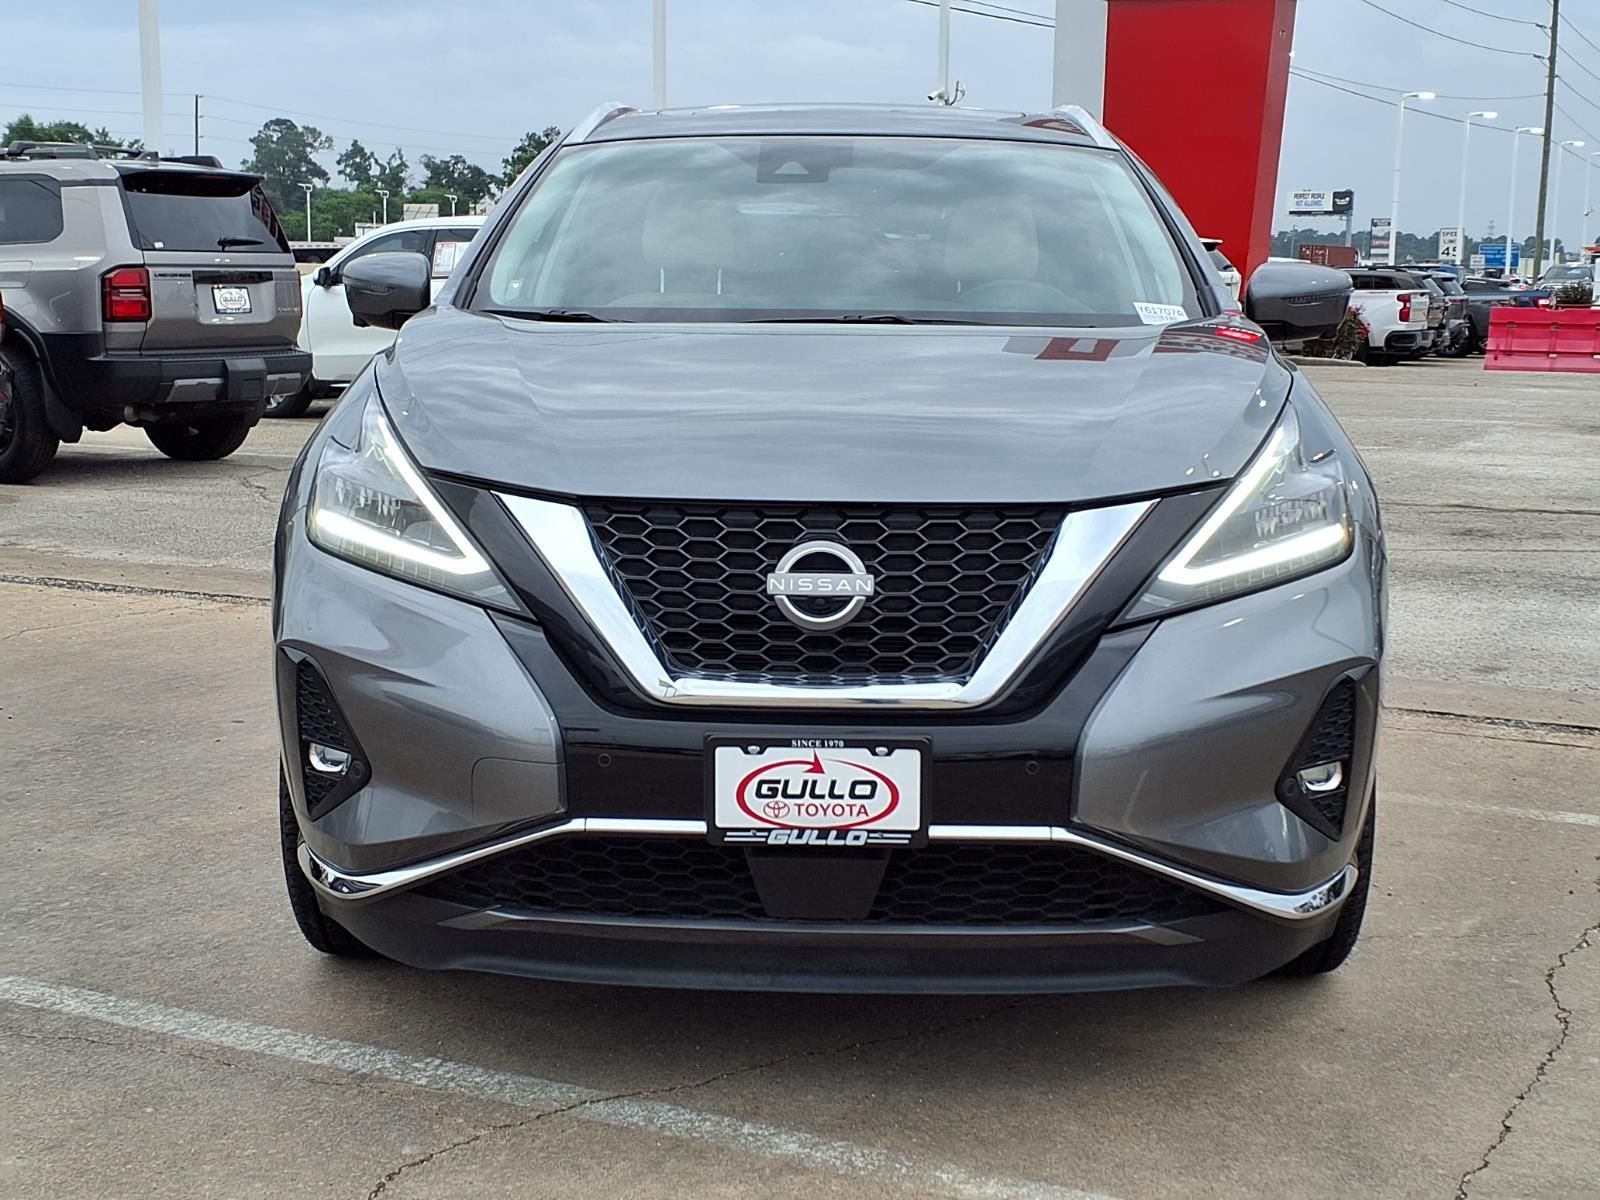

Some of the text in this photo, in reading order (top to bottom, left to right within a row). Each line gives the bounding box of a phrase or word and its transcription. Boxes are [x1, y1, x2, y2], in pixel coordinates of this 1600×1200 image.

[769, 578, 872, 592] NISSAN
[791, 739, 845, 748] SINCE 1970
[755, 779, 878, 800] GULLO
[794, 803, 869, 817] TOYOTA
[766, 829, 868, 846] GULLO
